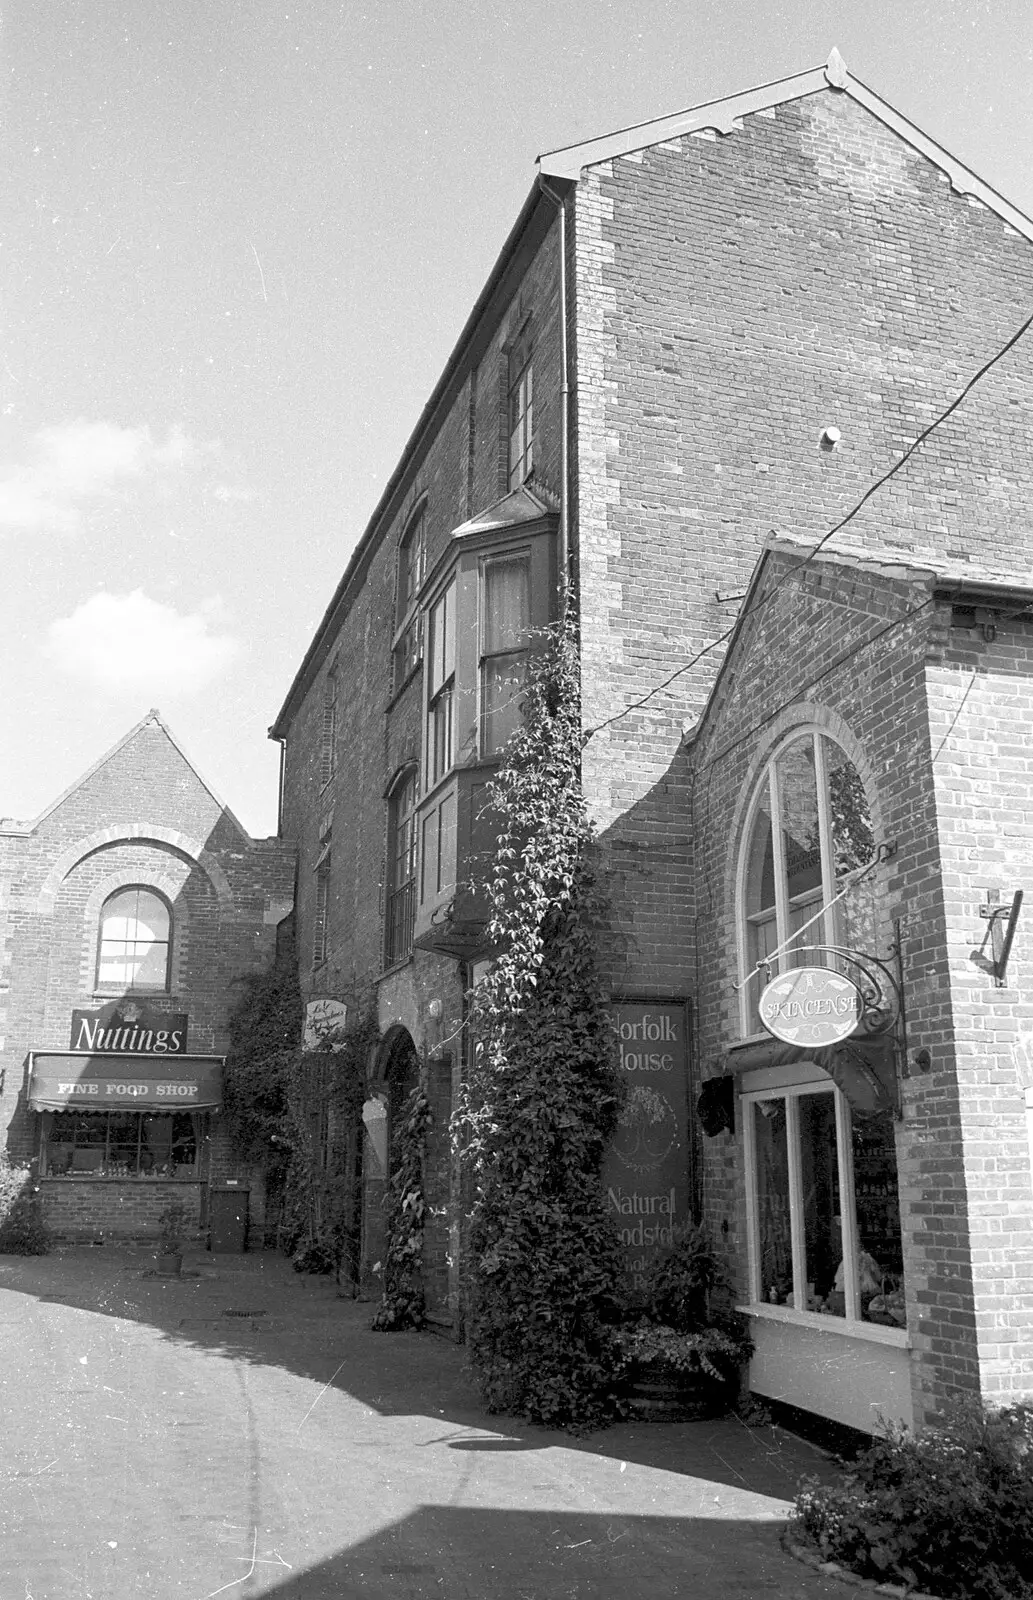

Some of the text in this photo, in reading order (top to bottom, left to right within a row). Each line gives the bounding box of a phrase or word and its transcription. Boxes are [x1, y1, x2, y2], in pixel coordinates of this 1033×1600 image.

[765, 994, 859, 1020] SKINCENSE
[74, 1018, 183, 1053] Nuttings
[57, 1083, 199, 1097] FINE FOOD SHOP
[607, 1186, 677, 1215] Natural
